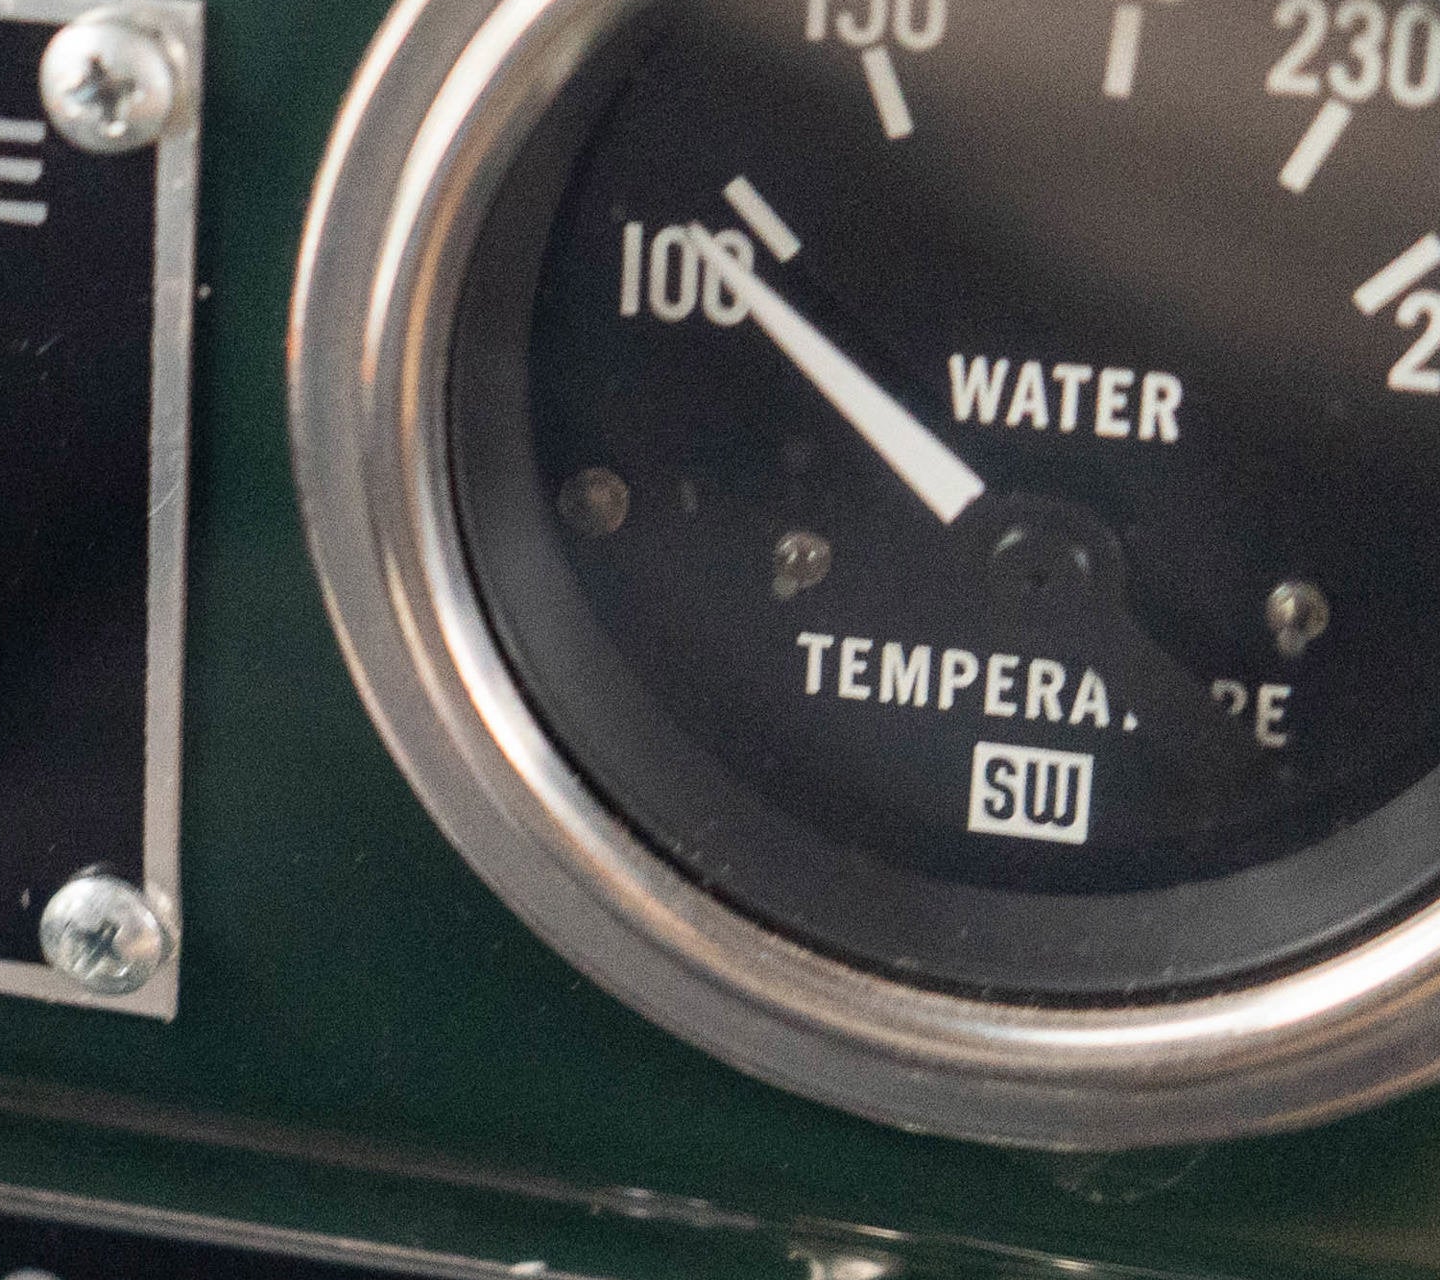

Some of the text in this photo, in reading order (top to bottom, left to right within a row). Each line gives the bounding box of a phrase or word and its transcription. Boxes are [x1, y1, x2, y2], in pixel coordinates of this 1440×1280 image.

[619, 221, 757, 326] 100
[947, 352, 1184, 444] WATER
[982, 755, 1086, 830] SW
